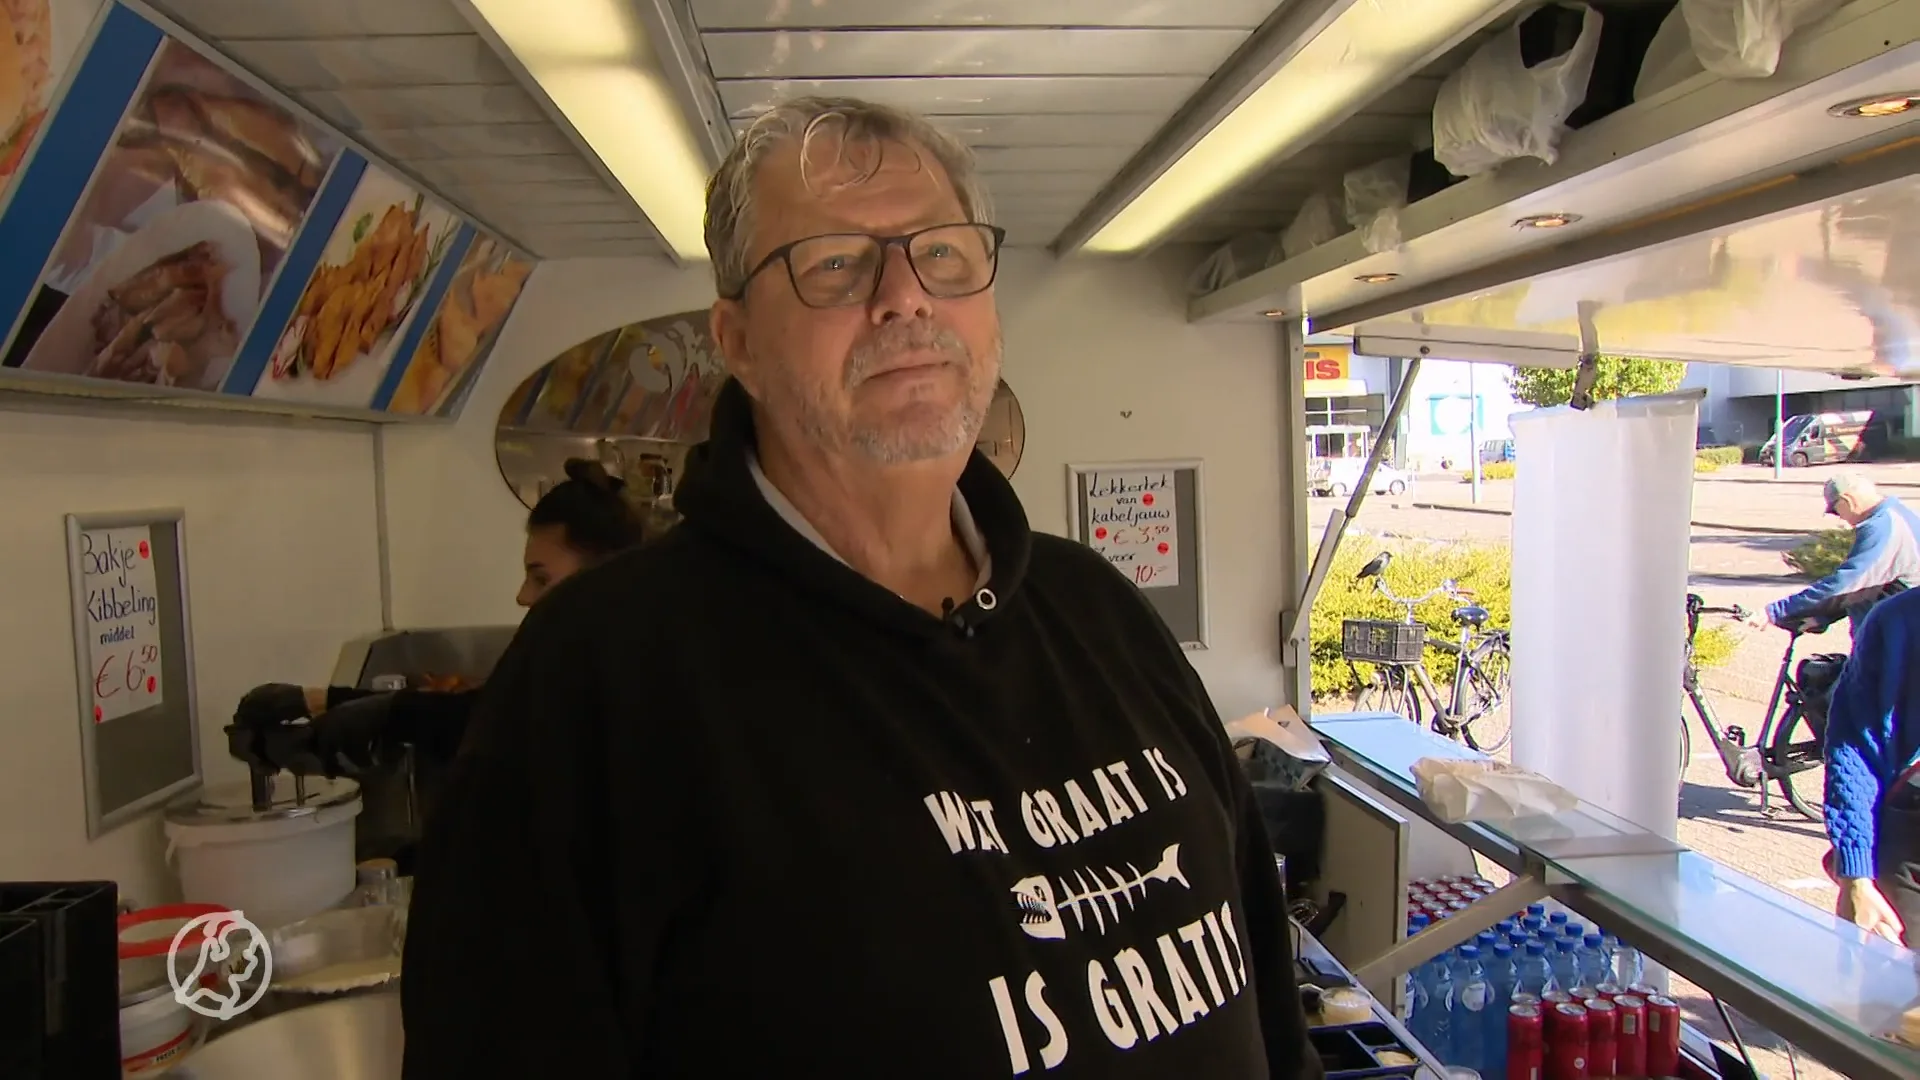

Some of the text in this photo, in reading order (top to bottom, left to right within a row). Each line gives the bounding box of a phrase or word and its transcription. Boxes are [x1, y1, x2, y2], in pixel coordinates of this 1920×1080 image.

[1092, 506, 1170, 528] kabeljauw
[1116, 497, 1137, 505] van
[82, 533, 136, 588] Bakje
[87, 585, 157, 626] Kibbeling
[100, 625, 135, 645] middel
[1021, 760, 1149, 848] GRAAT
[1142, 747, 1187, 801] IS
[989, 901, 1247, 1075] IS GRATIS
